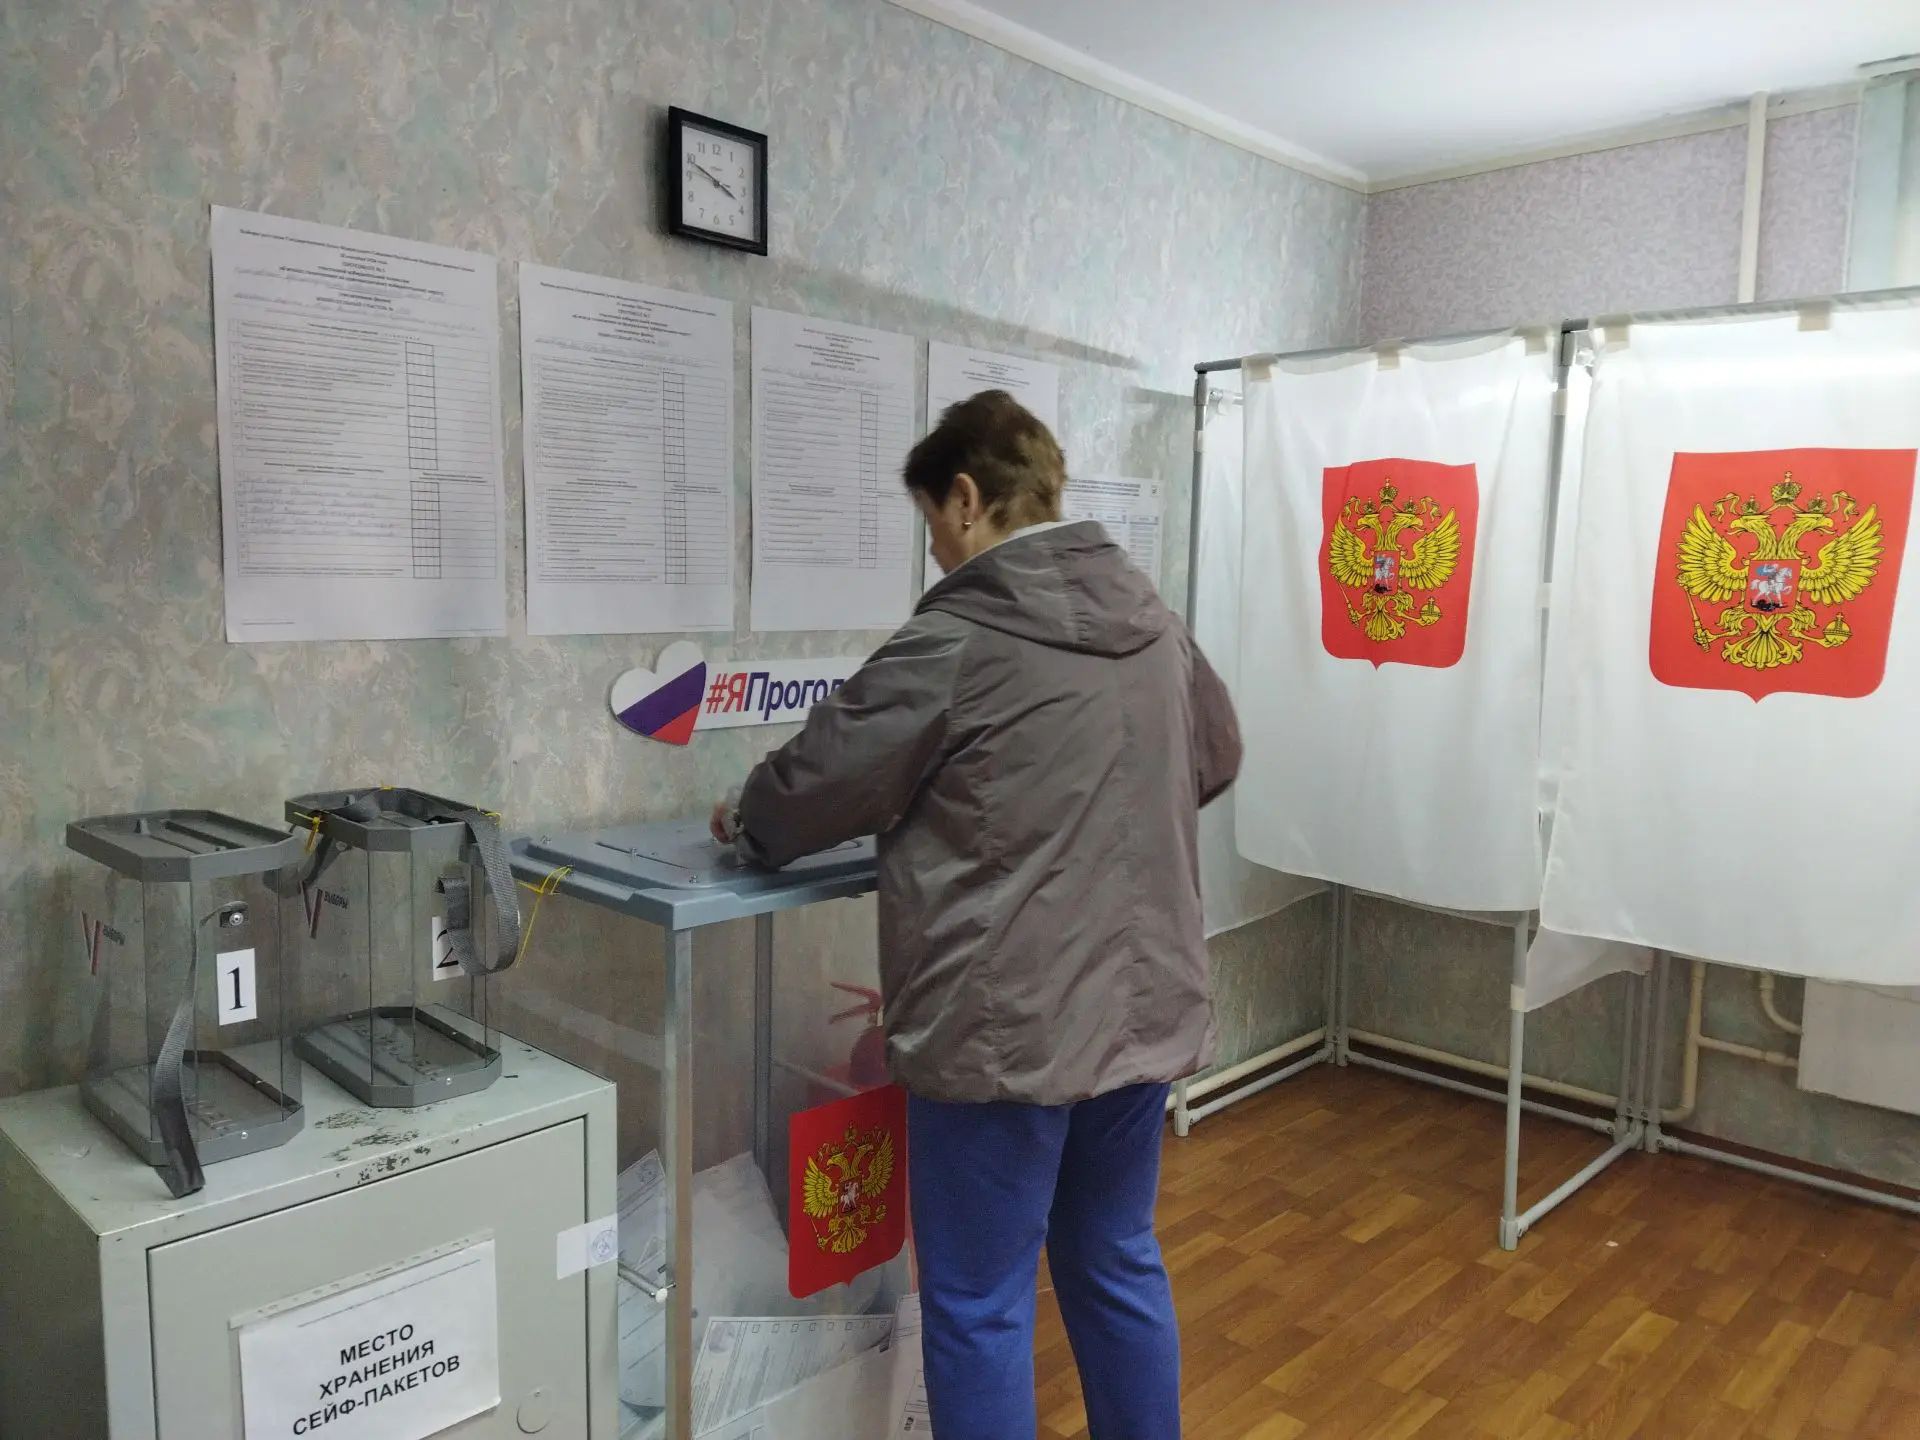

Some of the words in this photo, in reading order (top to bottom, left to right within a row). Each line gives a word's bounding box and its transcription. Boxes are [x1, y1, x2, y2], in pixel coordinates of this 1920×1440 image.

[696, 141, 706, 154] 11
[711, 143, 722, 156] 12
[686, 152, 696, 165] 10
[686, 170, 693, 181] 9
[736, 167, 745, 178] 2
[687, 190, 695, 202] 8
[740, 186, 746, 198] 3
[698, 207, 705, 219] 7
[738, 205, 745, 216] 4
[713, 215, 720, 226] 6
[728, 213, 735, 226] 5
[435, 927, 460, 969] 2
[226, 966, 248, 1011] 1
[339, 1323, 415, 1366] МЕСТО
[319, 1339, 436, 1401] ХРАНЕНИЯ
[292, 1354, 461, 1436] СЕЙФ-ПАКЕТОВ
